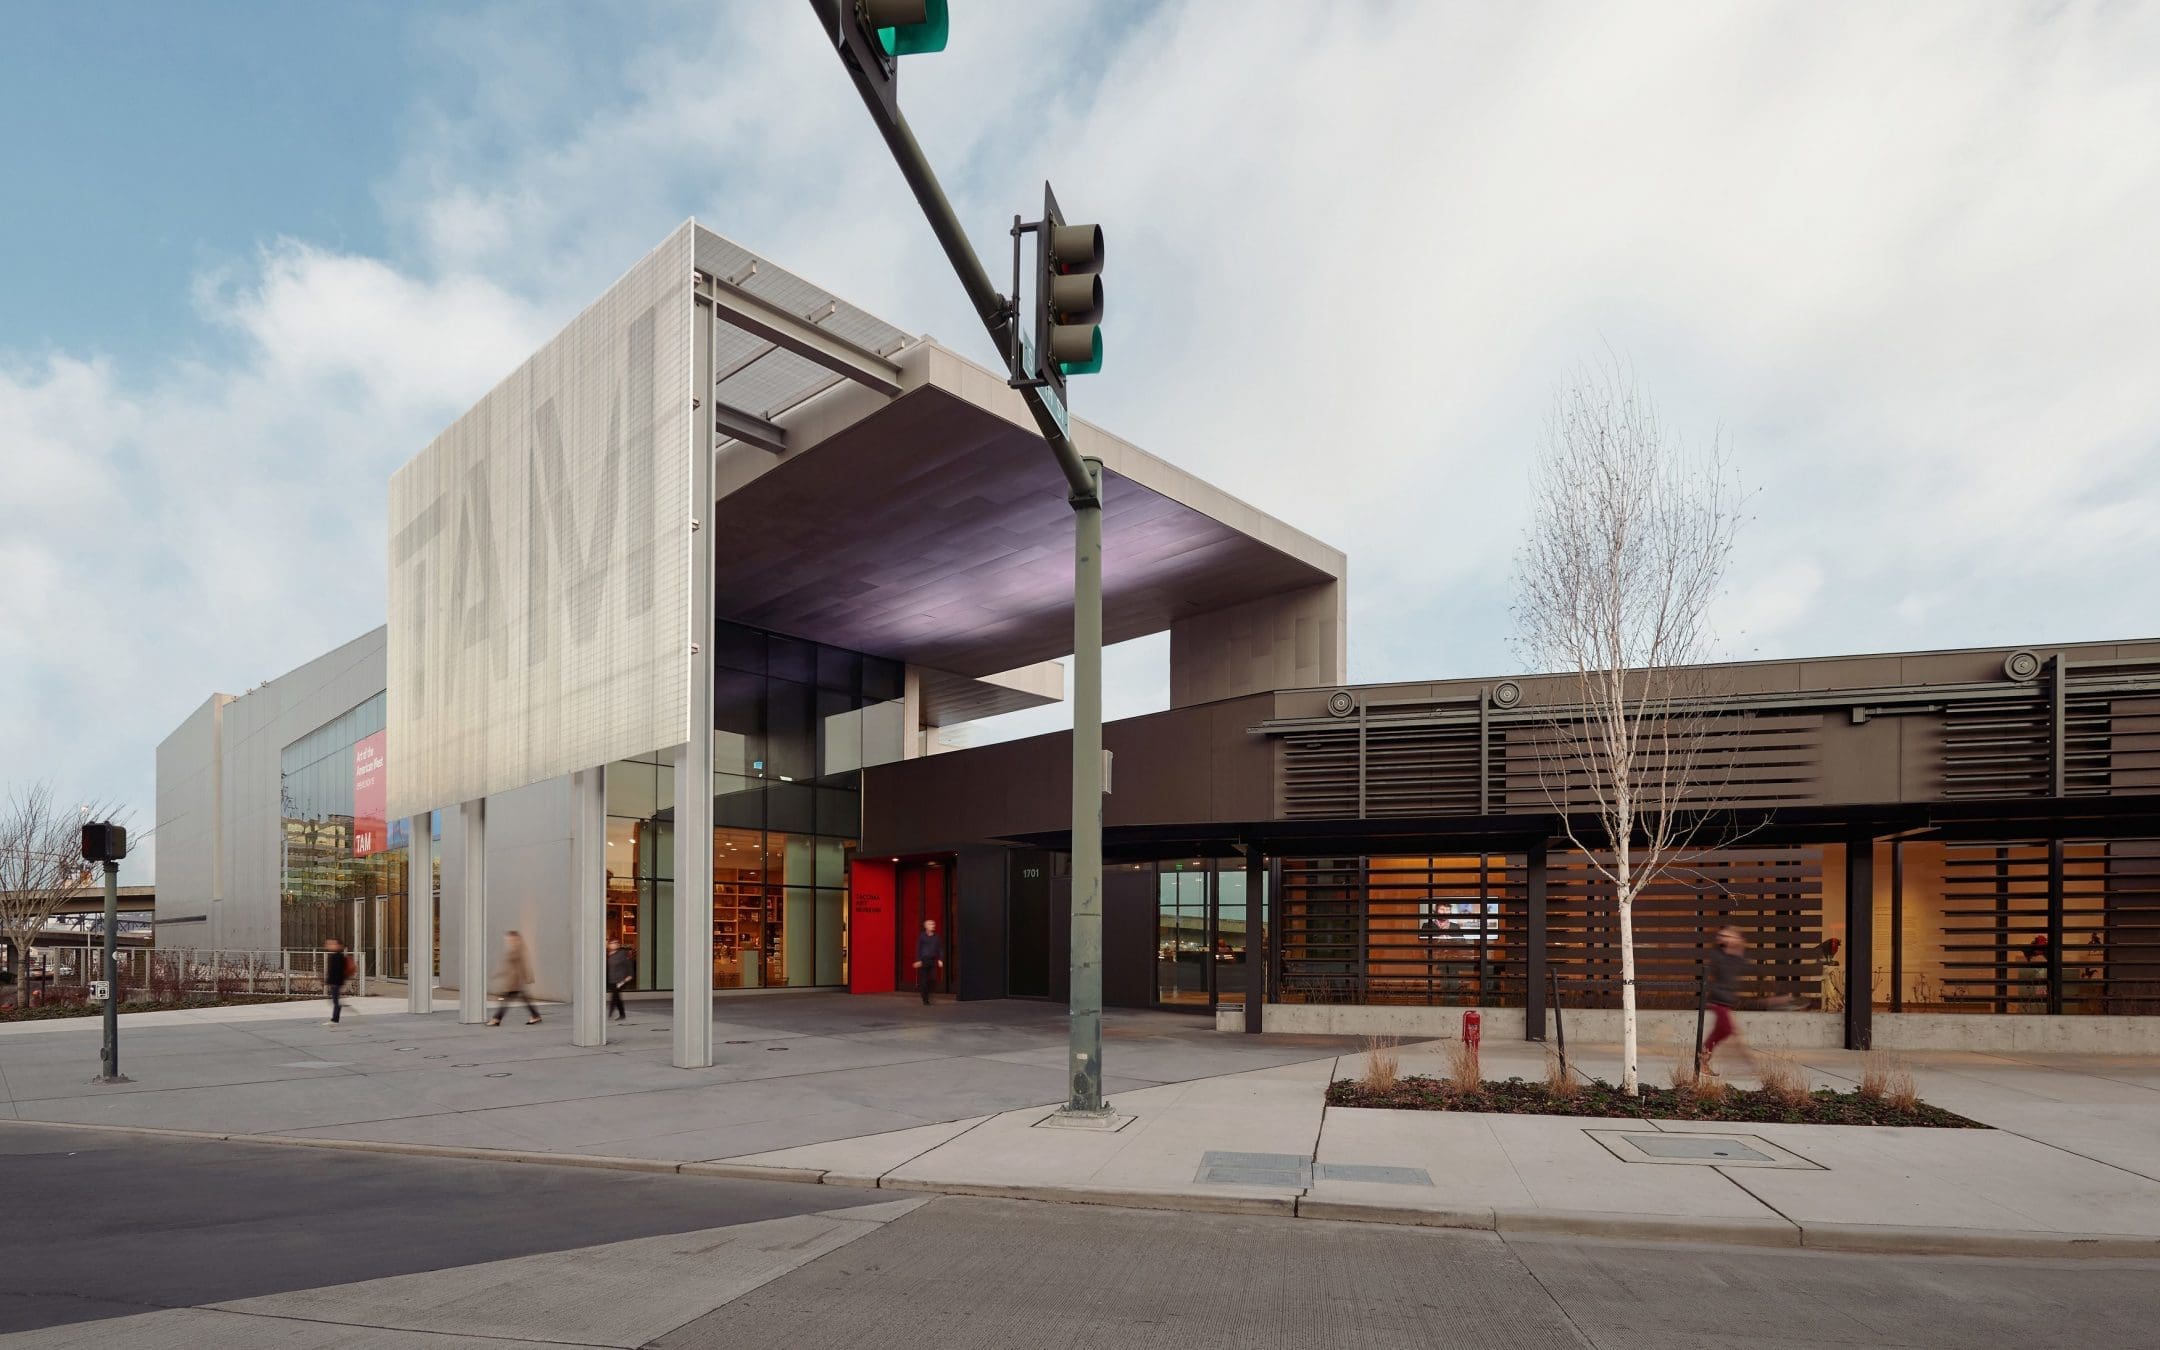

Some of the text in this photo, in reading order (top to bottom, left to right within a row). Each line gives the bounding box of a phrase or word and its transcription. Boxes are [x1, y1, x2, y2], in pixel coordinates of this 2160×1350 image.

[1056, 397, 1064, 425] ST
[394, 305, 655, 721] TAM
[355, 832, 371, 853] TAM
[1023, 868, 1039, 878] 1701
